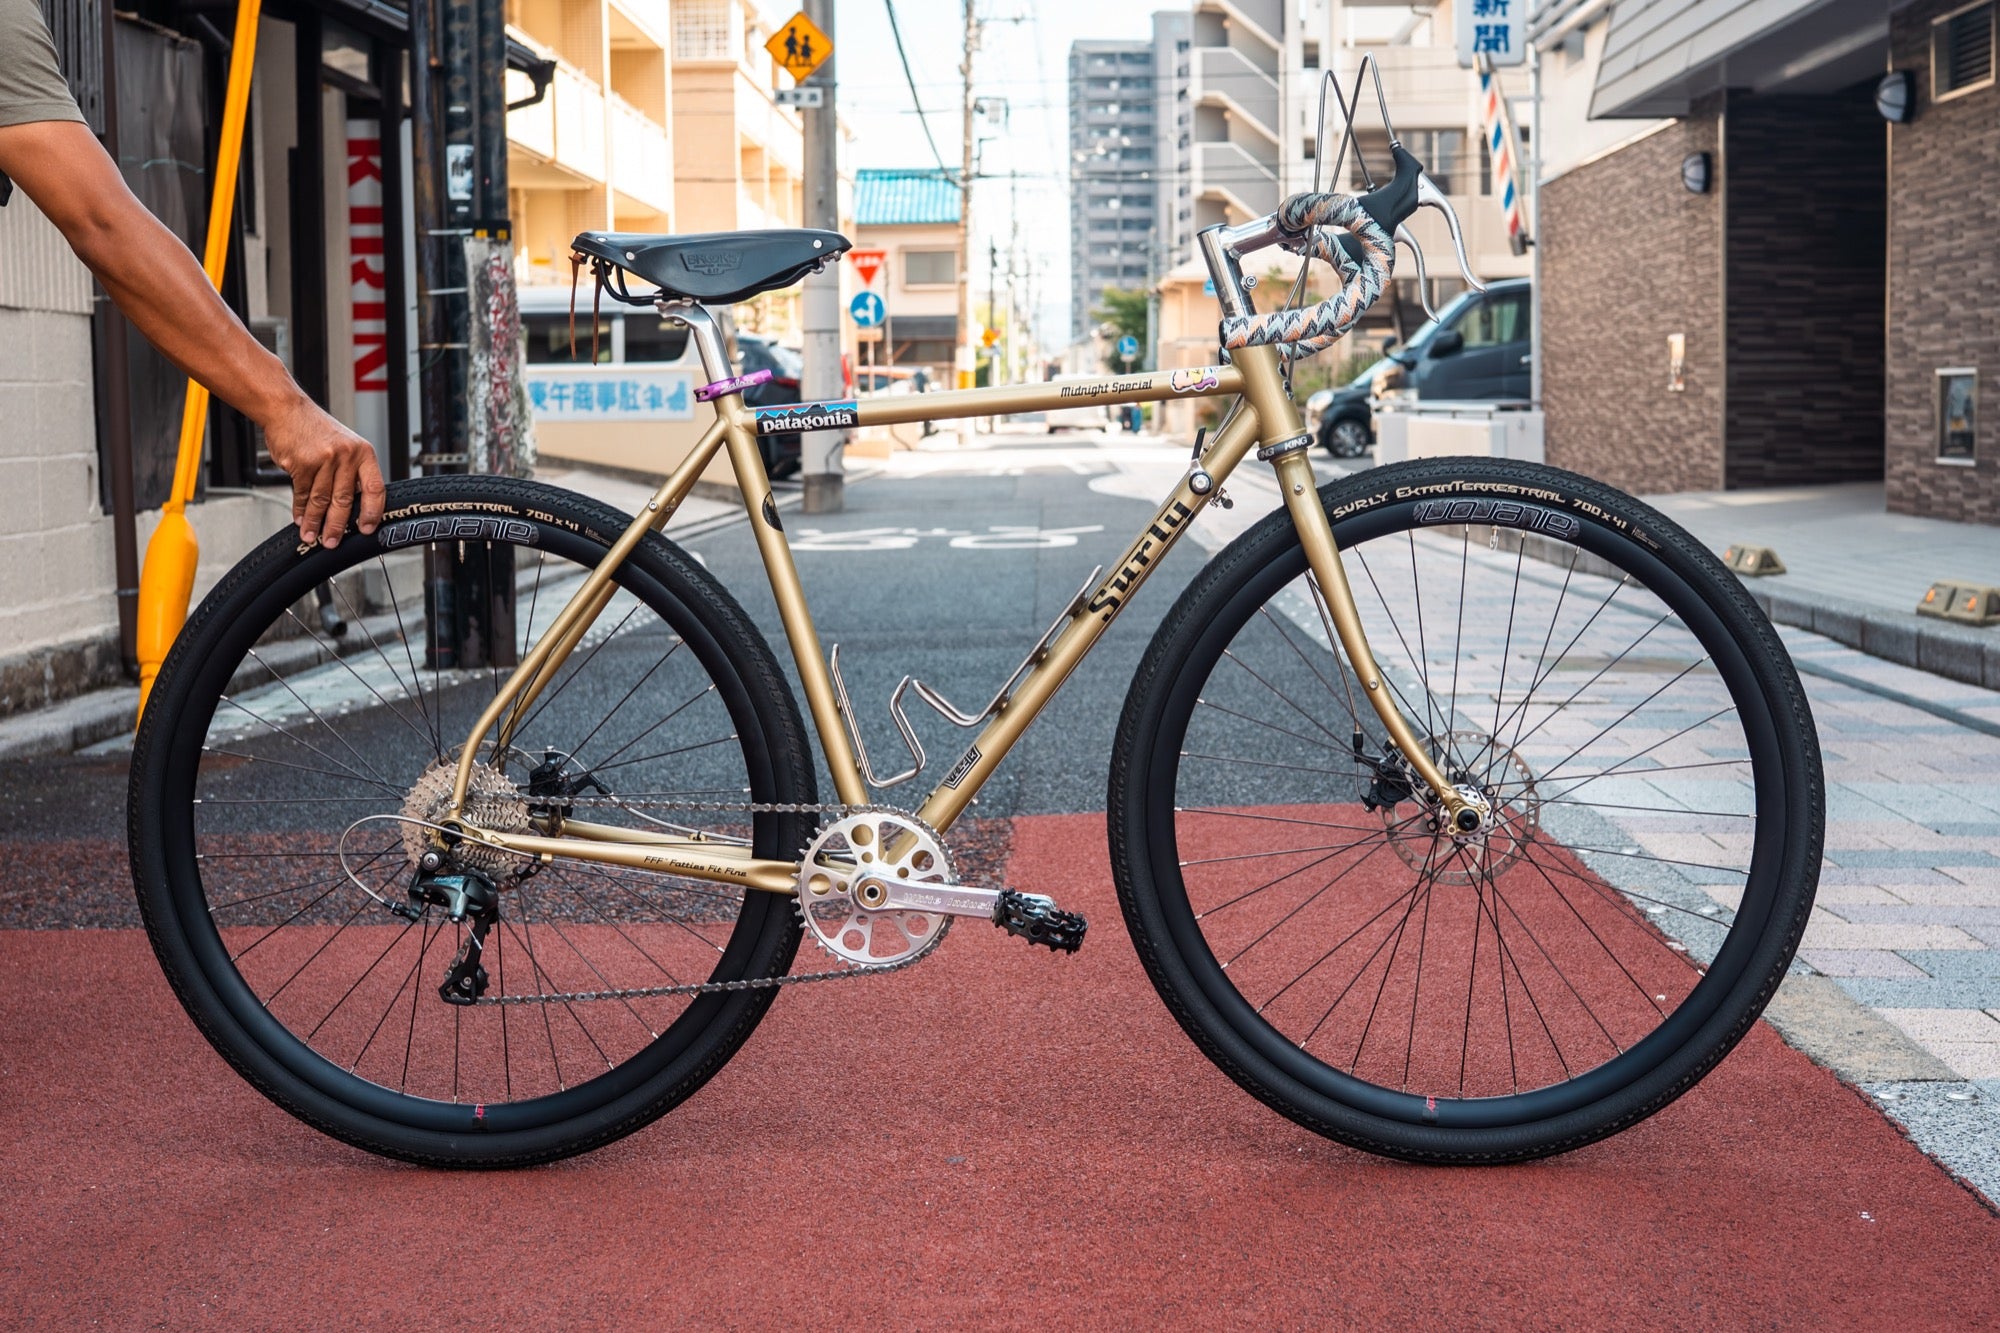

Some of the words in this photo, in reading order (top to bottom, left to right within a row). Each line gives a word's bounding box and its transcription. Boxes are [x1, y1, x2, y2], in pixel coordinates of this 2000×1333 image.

[347, 139, 388, 391] KIRIN
[1060, 383, 1109, 398] Midnight
[1112, 379, 1153, 395] Special
[762, 411, 853, 434] patagonia
[1284, 435, 1308, 451] KING
[525, 508, 554, 524] 700
[562, 519, 579, 532] 41
[1332, 491, 1389, 519] SURLY
[1573, 498, 1602, 516] 700
[1612, 515, 1628, 530] 41
[1087, 500, 1195, 623] Surly
[669, 858, 705, 871] Fatties
[707, 864, 722, 874] Fit
[724, 866, 747, 877] Fine
